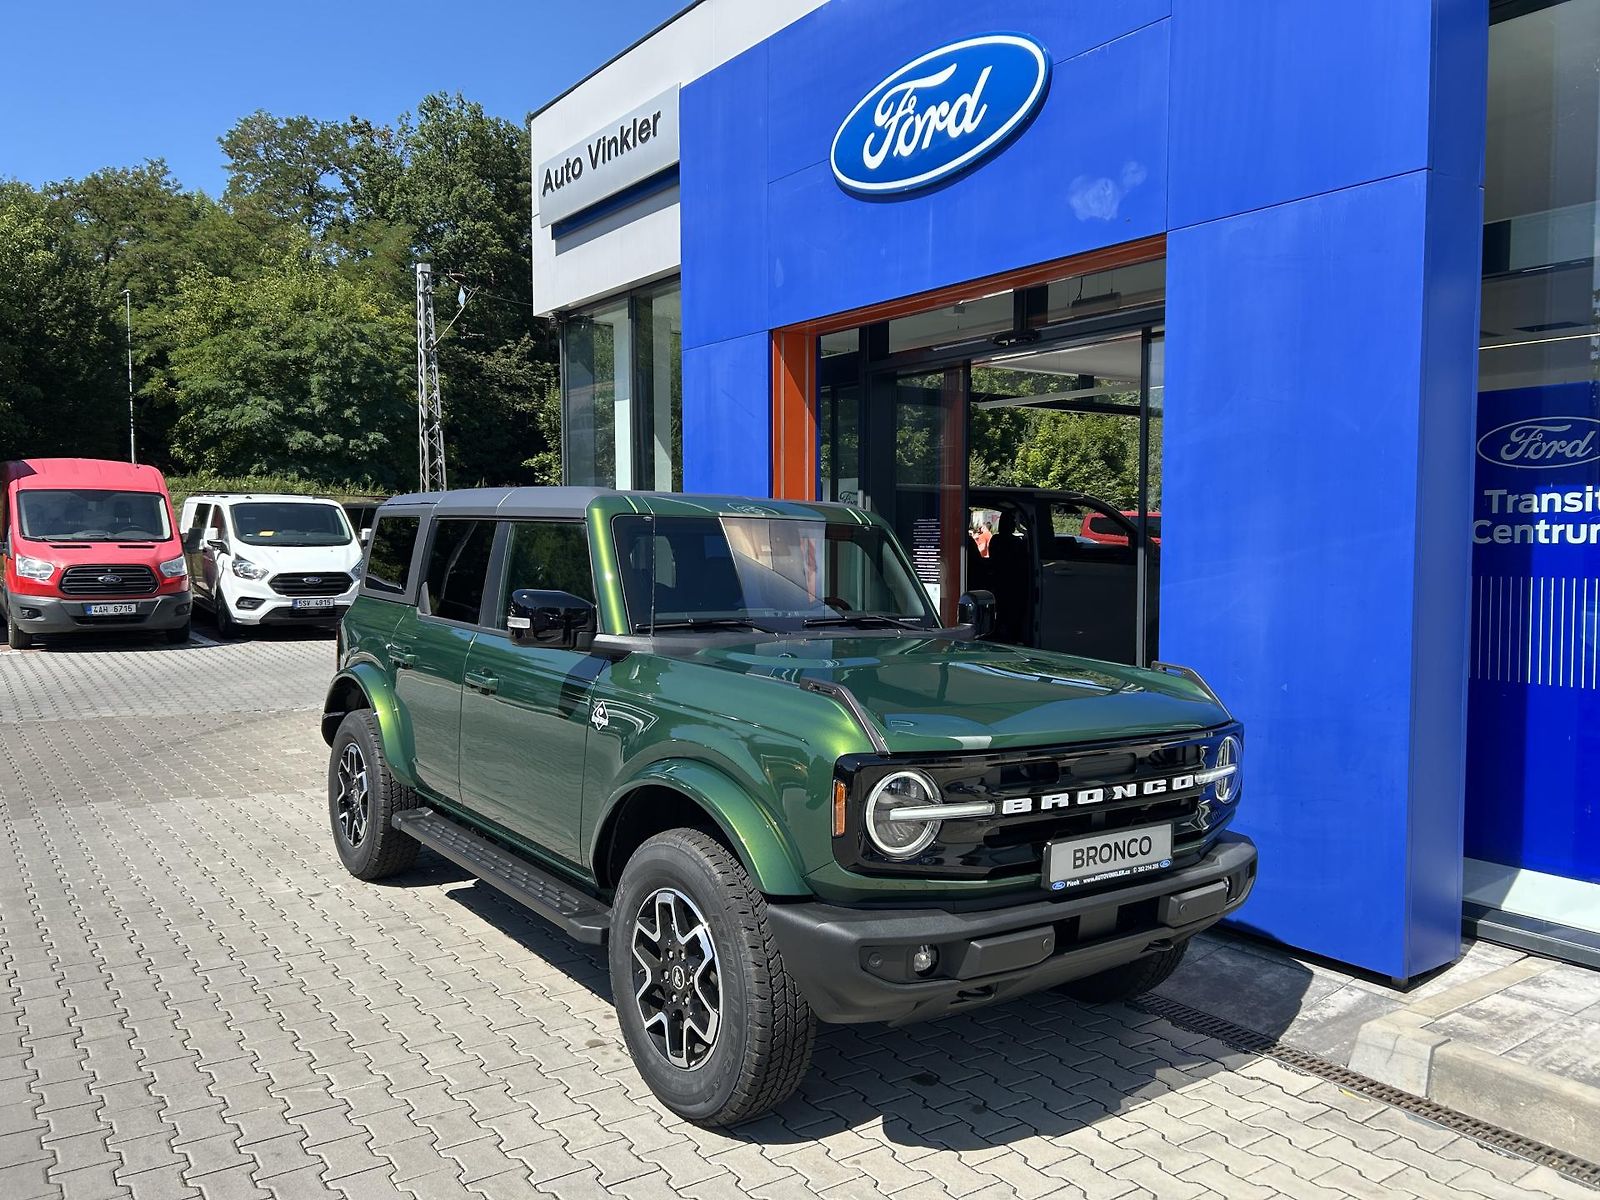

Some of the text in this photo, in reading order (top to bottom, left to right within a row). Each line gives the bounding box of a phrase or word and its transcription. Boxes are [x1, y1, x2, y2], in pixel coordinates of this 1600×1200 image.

[863, 63, 993, 170] Ford
[542, 110, 661, 197] Auto Vinkler
[1500, 424, 1596, 461] Ford
[113, 604, 133, 612] 6715
[1002, 774, 1193, 814] BRONCO
[1072, 836, 1152, 869] BRONCO
